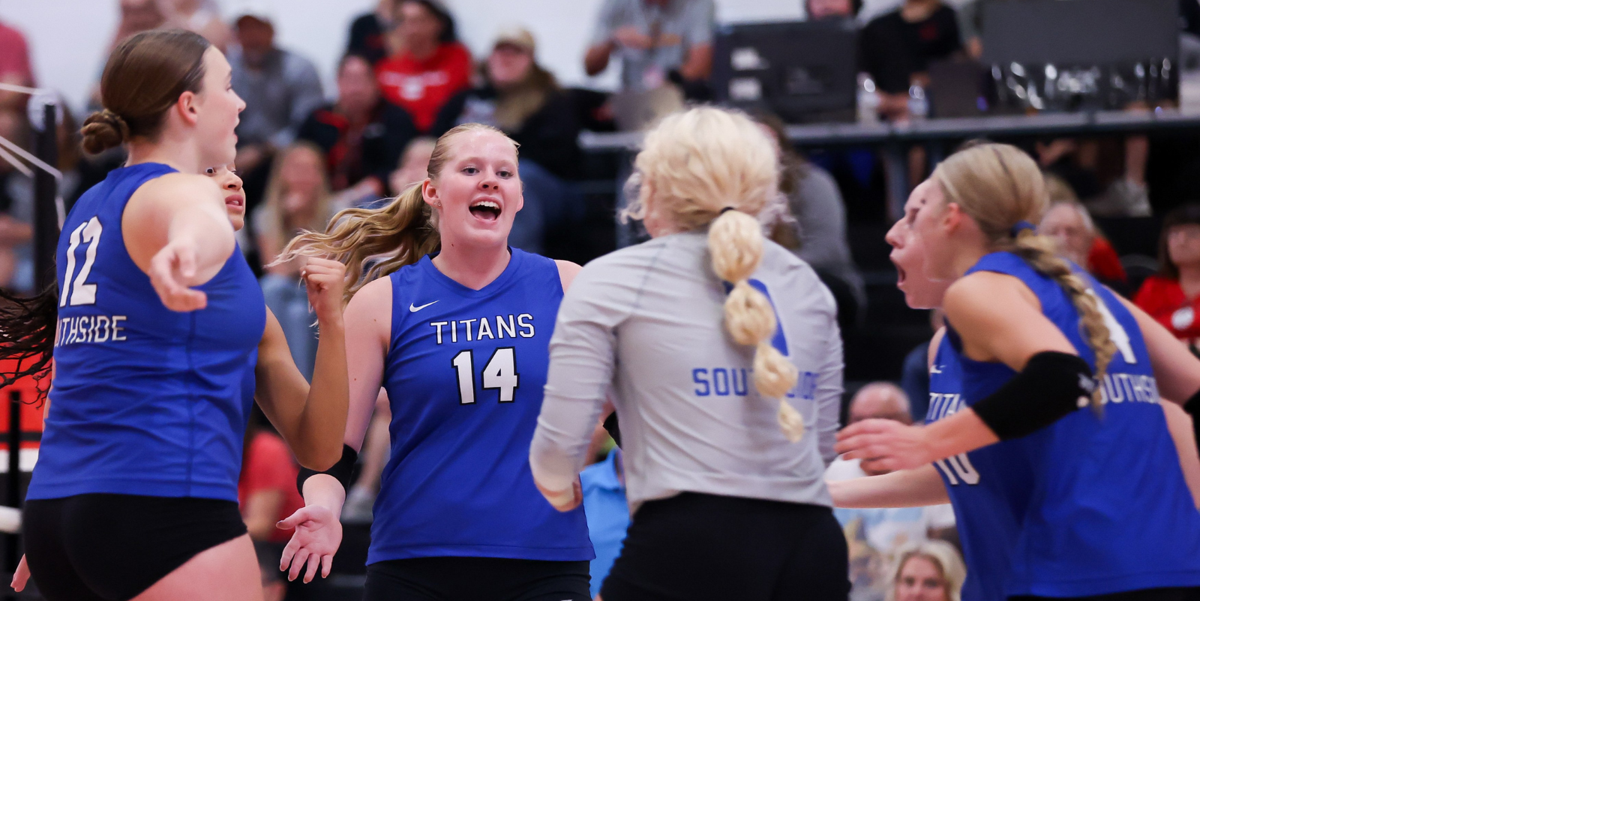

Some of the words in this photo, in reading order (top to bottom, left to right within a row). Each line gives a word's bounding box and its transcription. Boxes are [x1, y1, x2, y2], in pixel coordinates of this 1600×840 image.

[60, 216, 103, 308] 12
[430, 313, 536, 345] TITANS
[451, 346, 519, 406] 14
